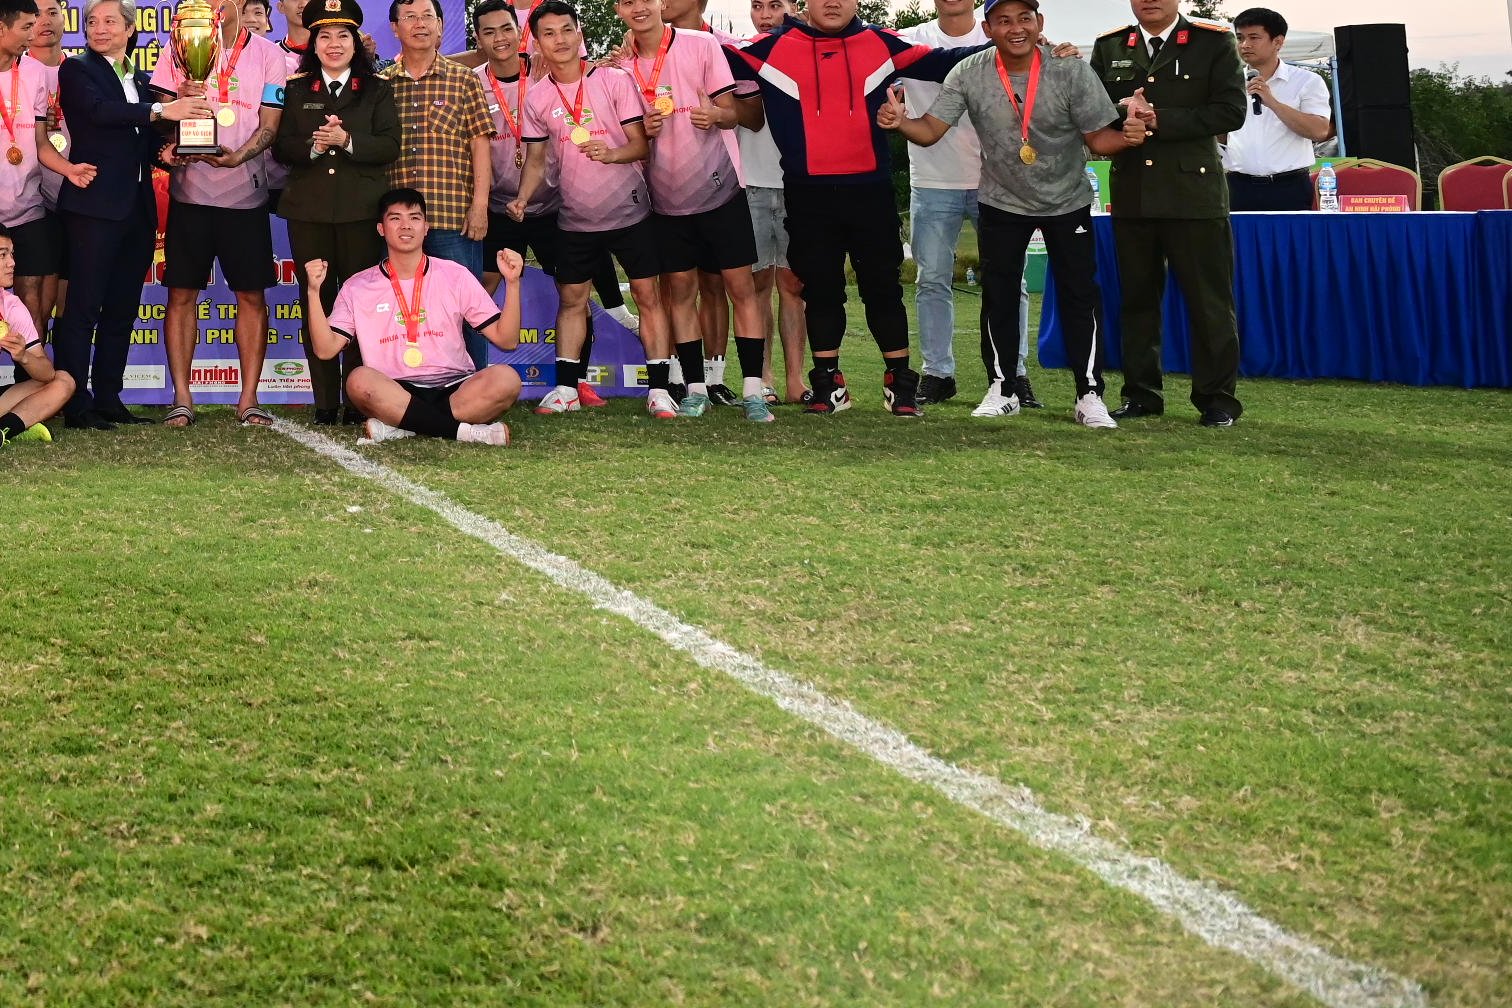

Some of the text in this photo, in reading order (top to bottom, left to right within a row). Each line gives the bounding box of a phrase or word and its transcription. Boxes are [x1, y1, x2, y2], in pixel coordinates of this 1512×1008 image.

[130, 38, 165, 71] TIỀ
[138, 303, 167, 323] ỤC
[276, 299, 303, 320] HẢ
